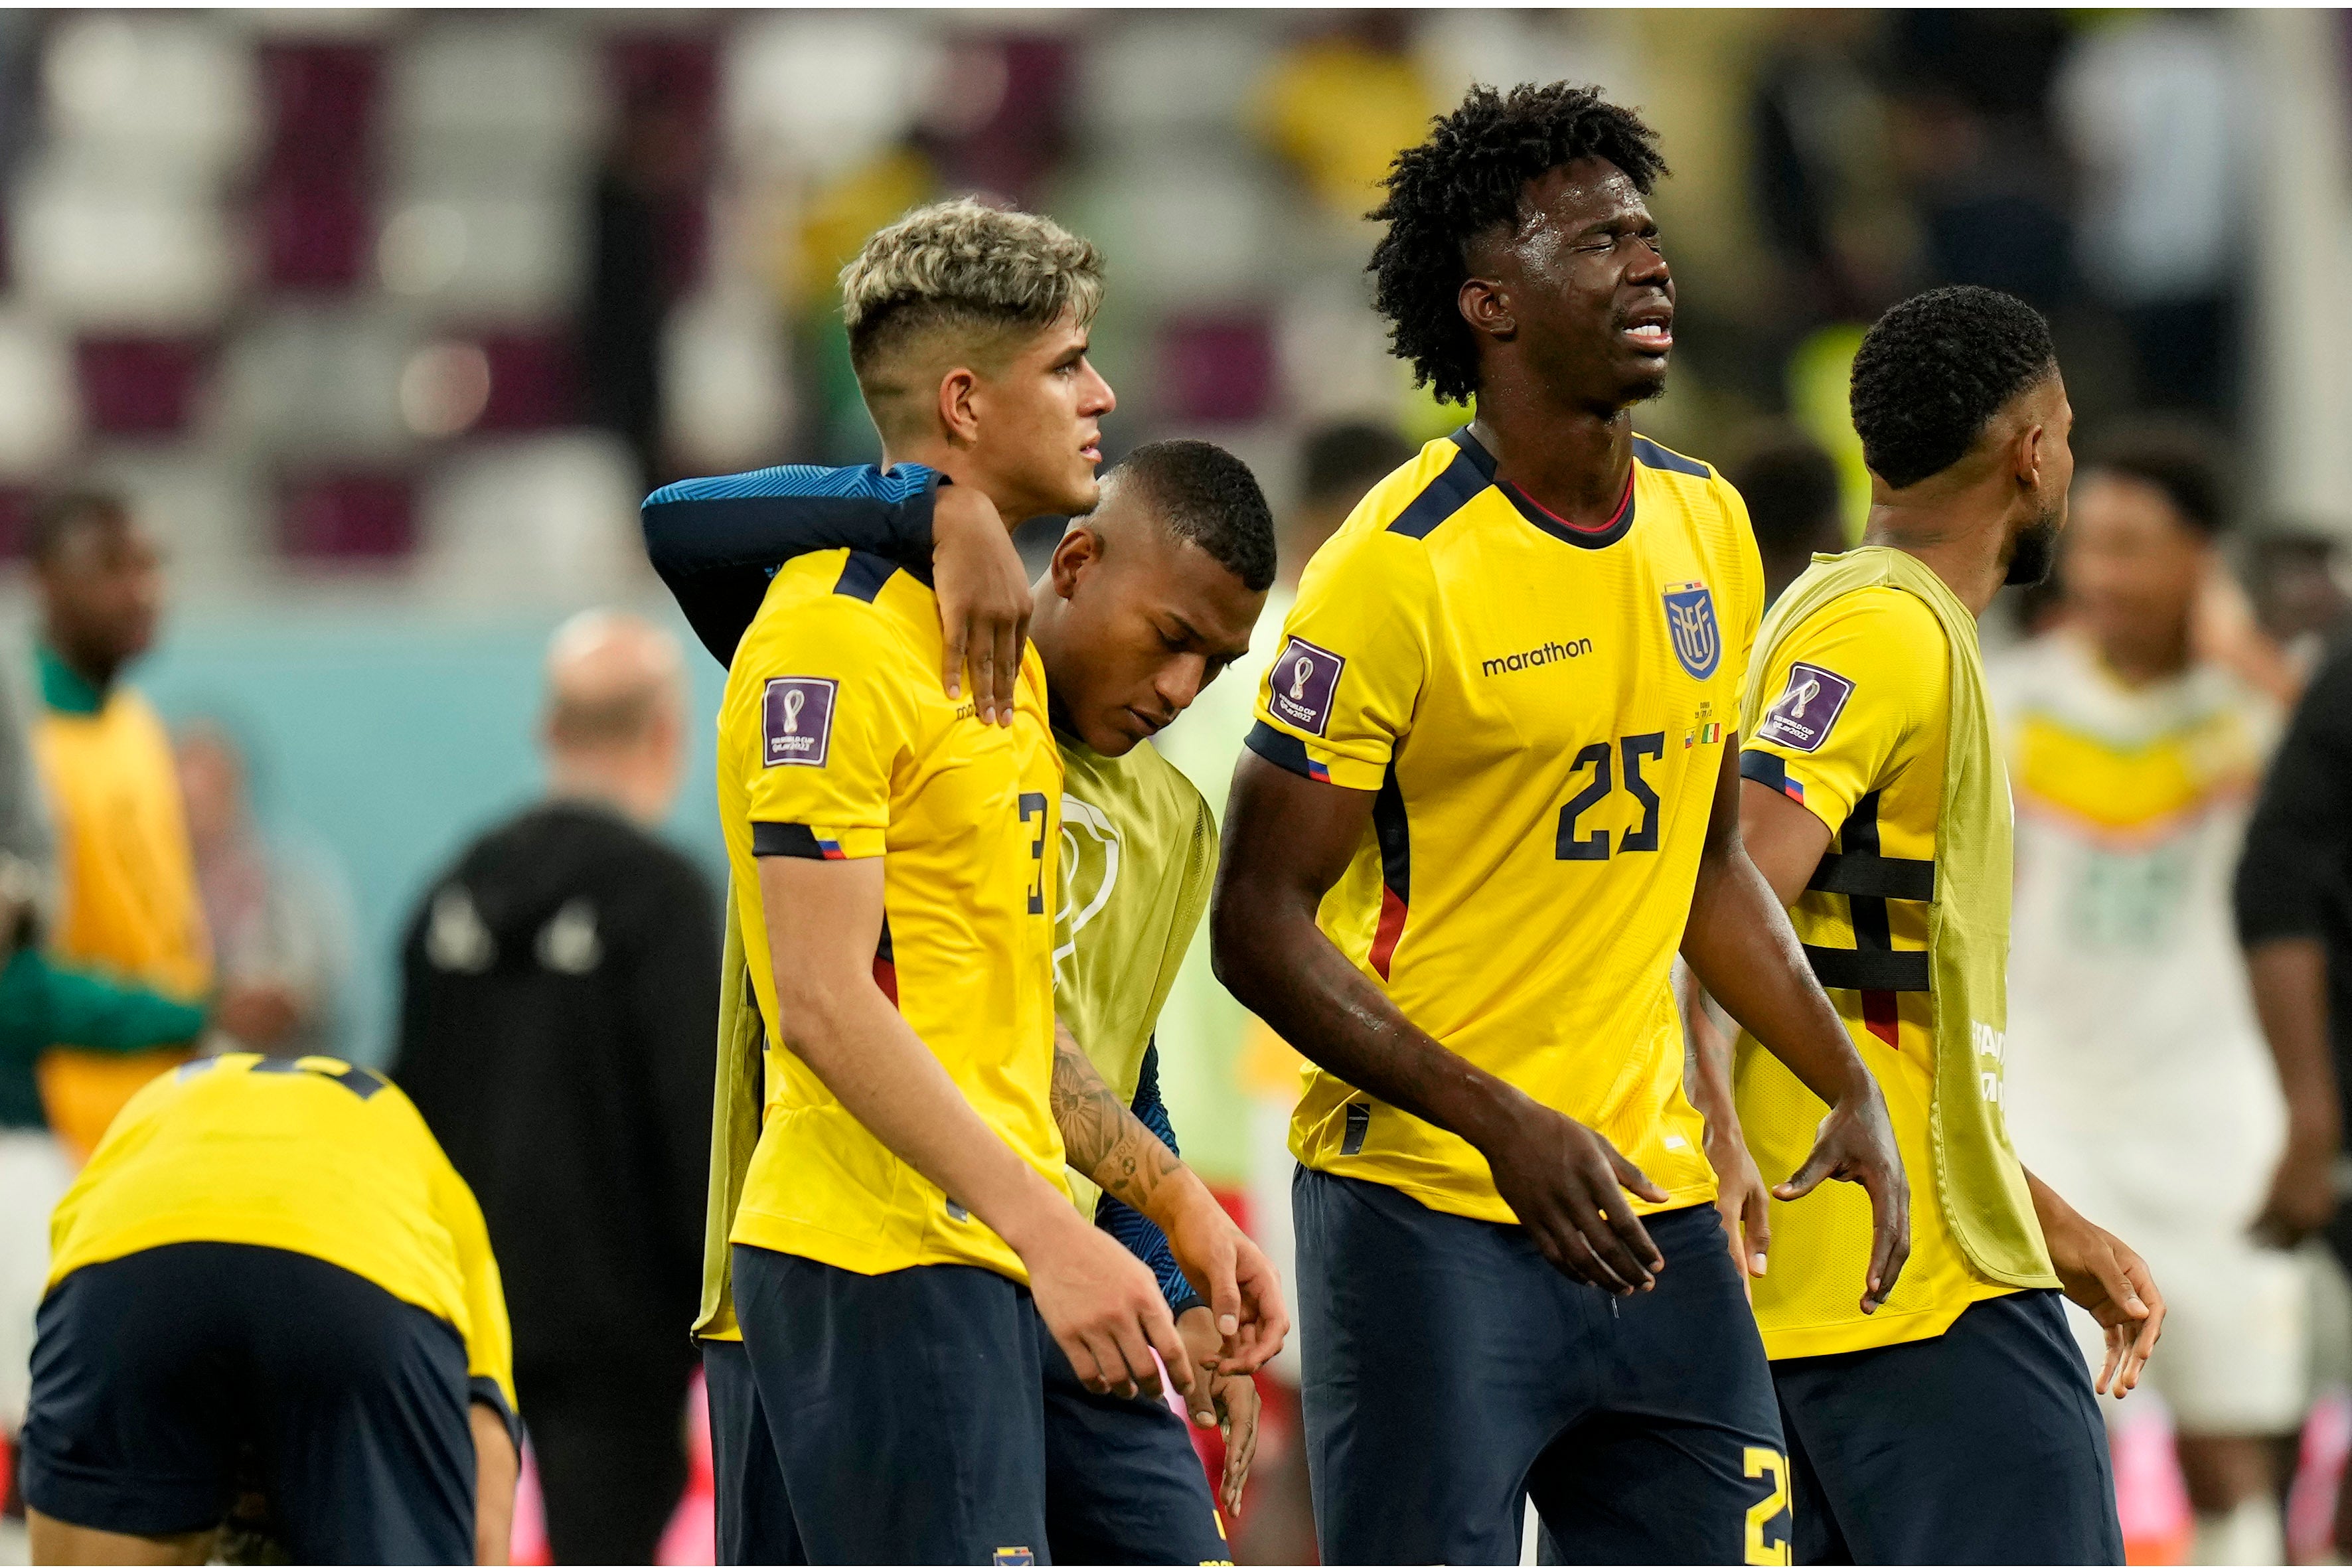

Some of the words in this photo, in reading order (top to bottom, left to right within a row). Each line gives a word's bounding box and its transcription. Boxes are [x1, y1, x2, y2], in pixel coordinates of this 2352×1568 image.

[1482, 638, 1592, 676] marathon
[1802, 726, 1814, 735] CUP
[1019, 793, 1048, 913] 3
[1555, 731, 1665, 860] 25
[1744, 1447, 1793, 1566] 2
